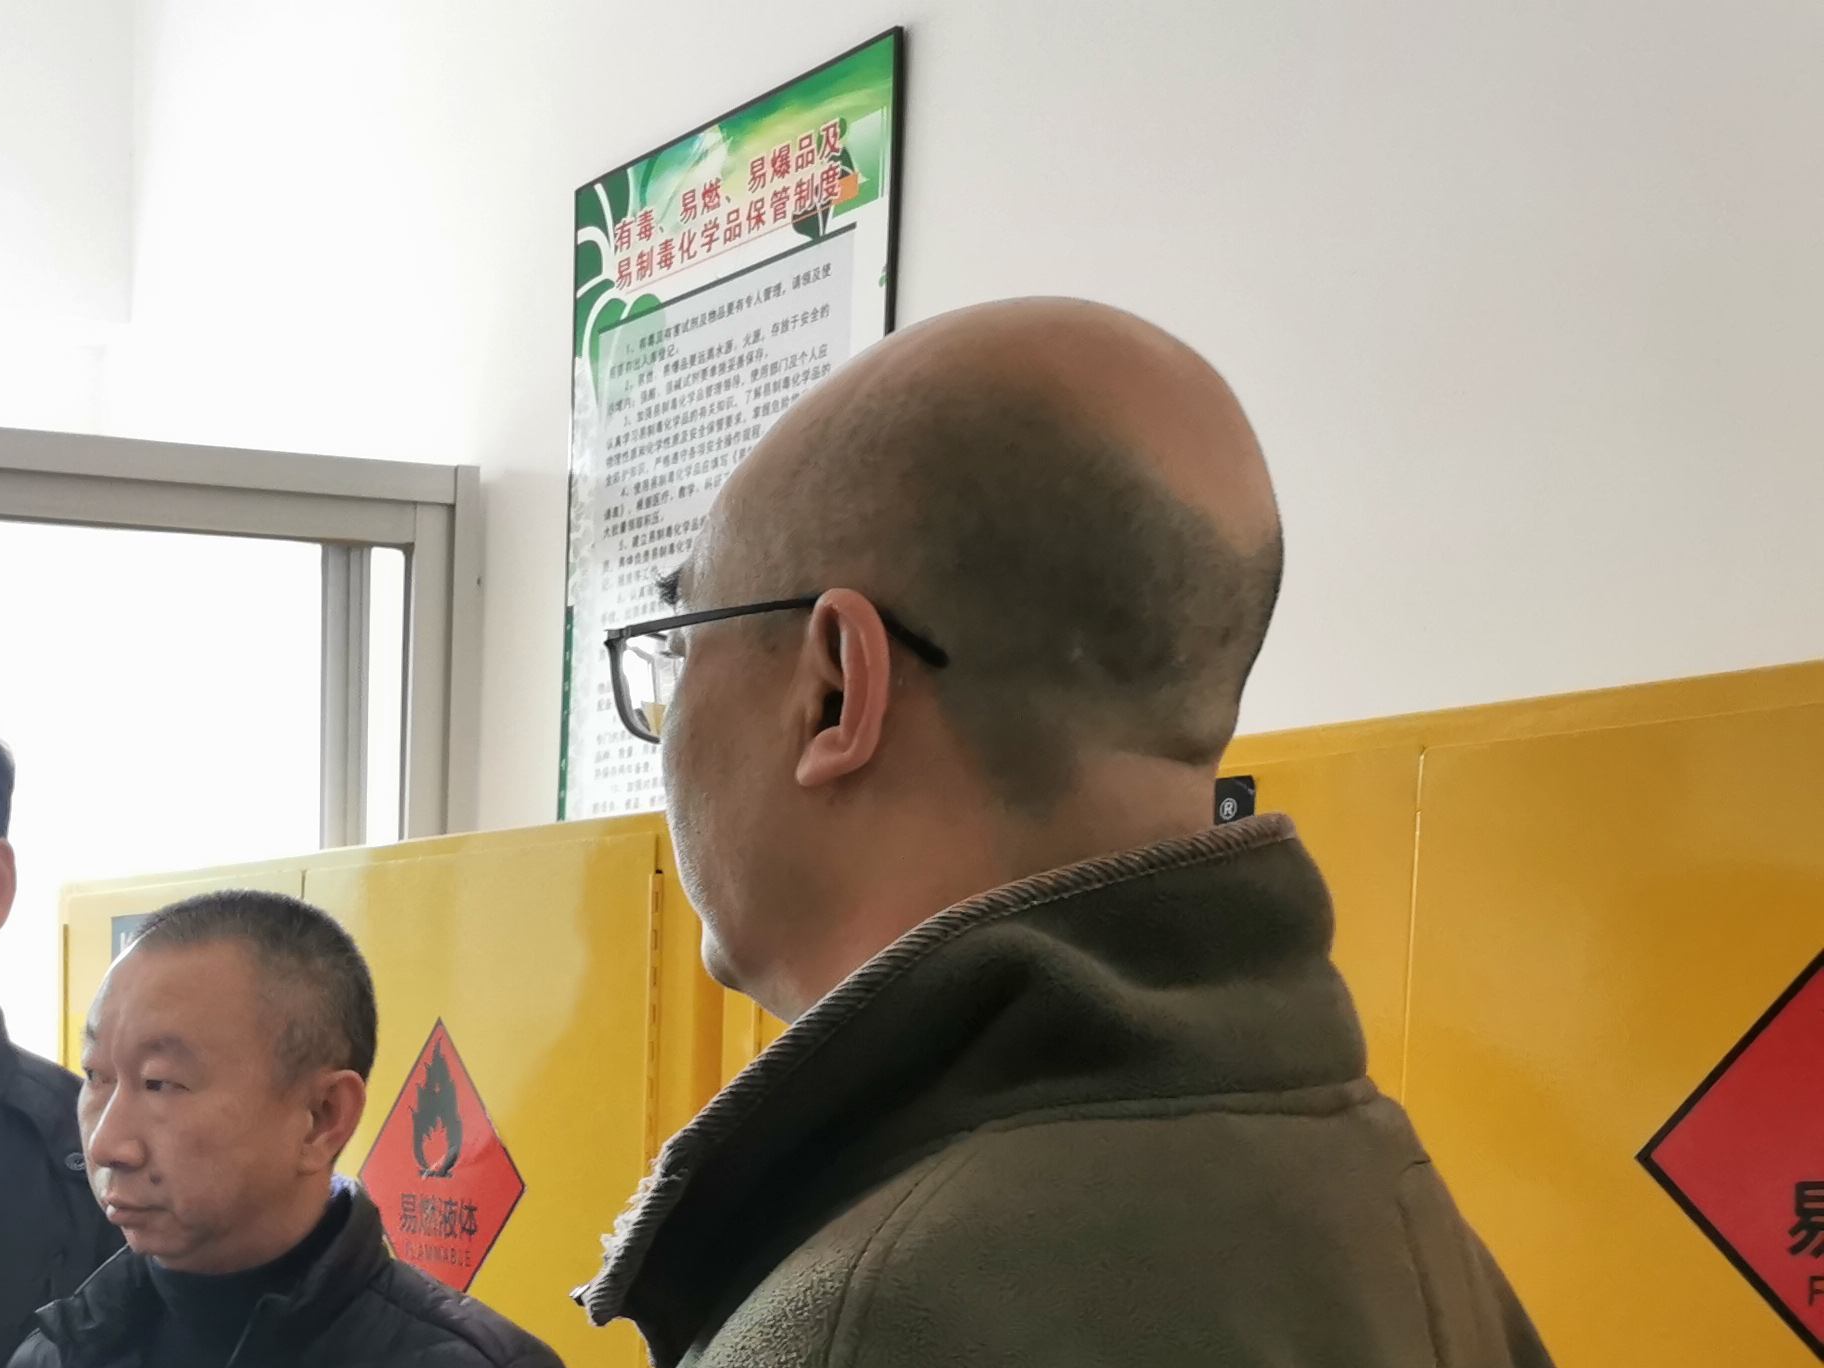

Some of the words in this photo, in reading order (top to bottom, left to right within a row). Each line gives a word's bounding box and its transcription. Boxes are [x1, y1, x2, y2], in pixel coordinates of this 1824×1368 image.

[615, 165, 842, 291] 易制毒化学品保管制度
